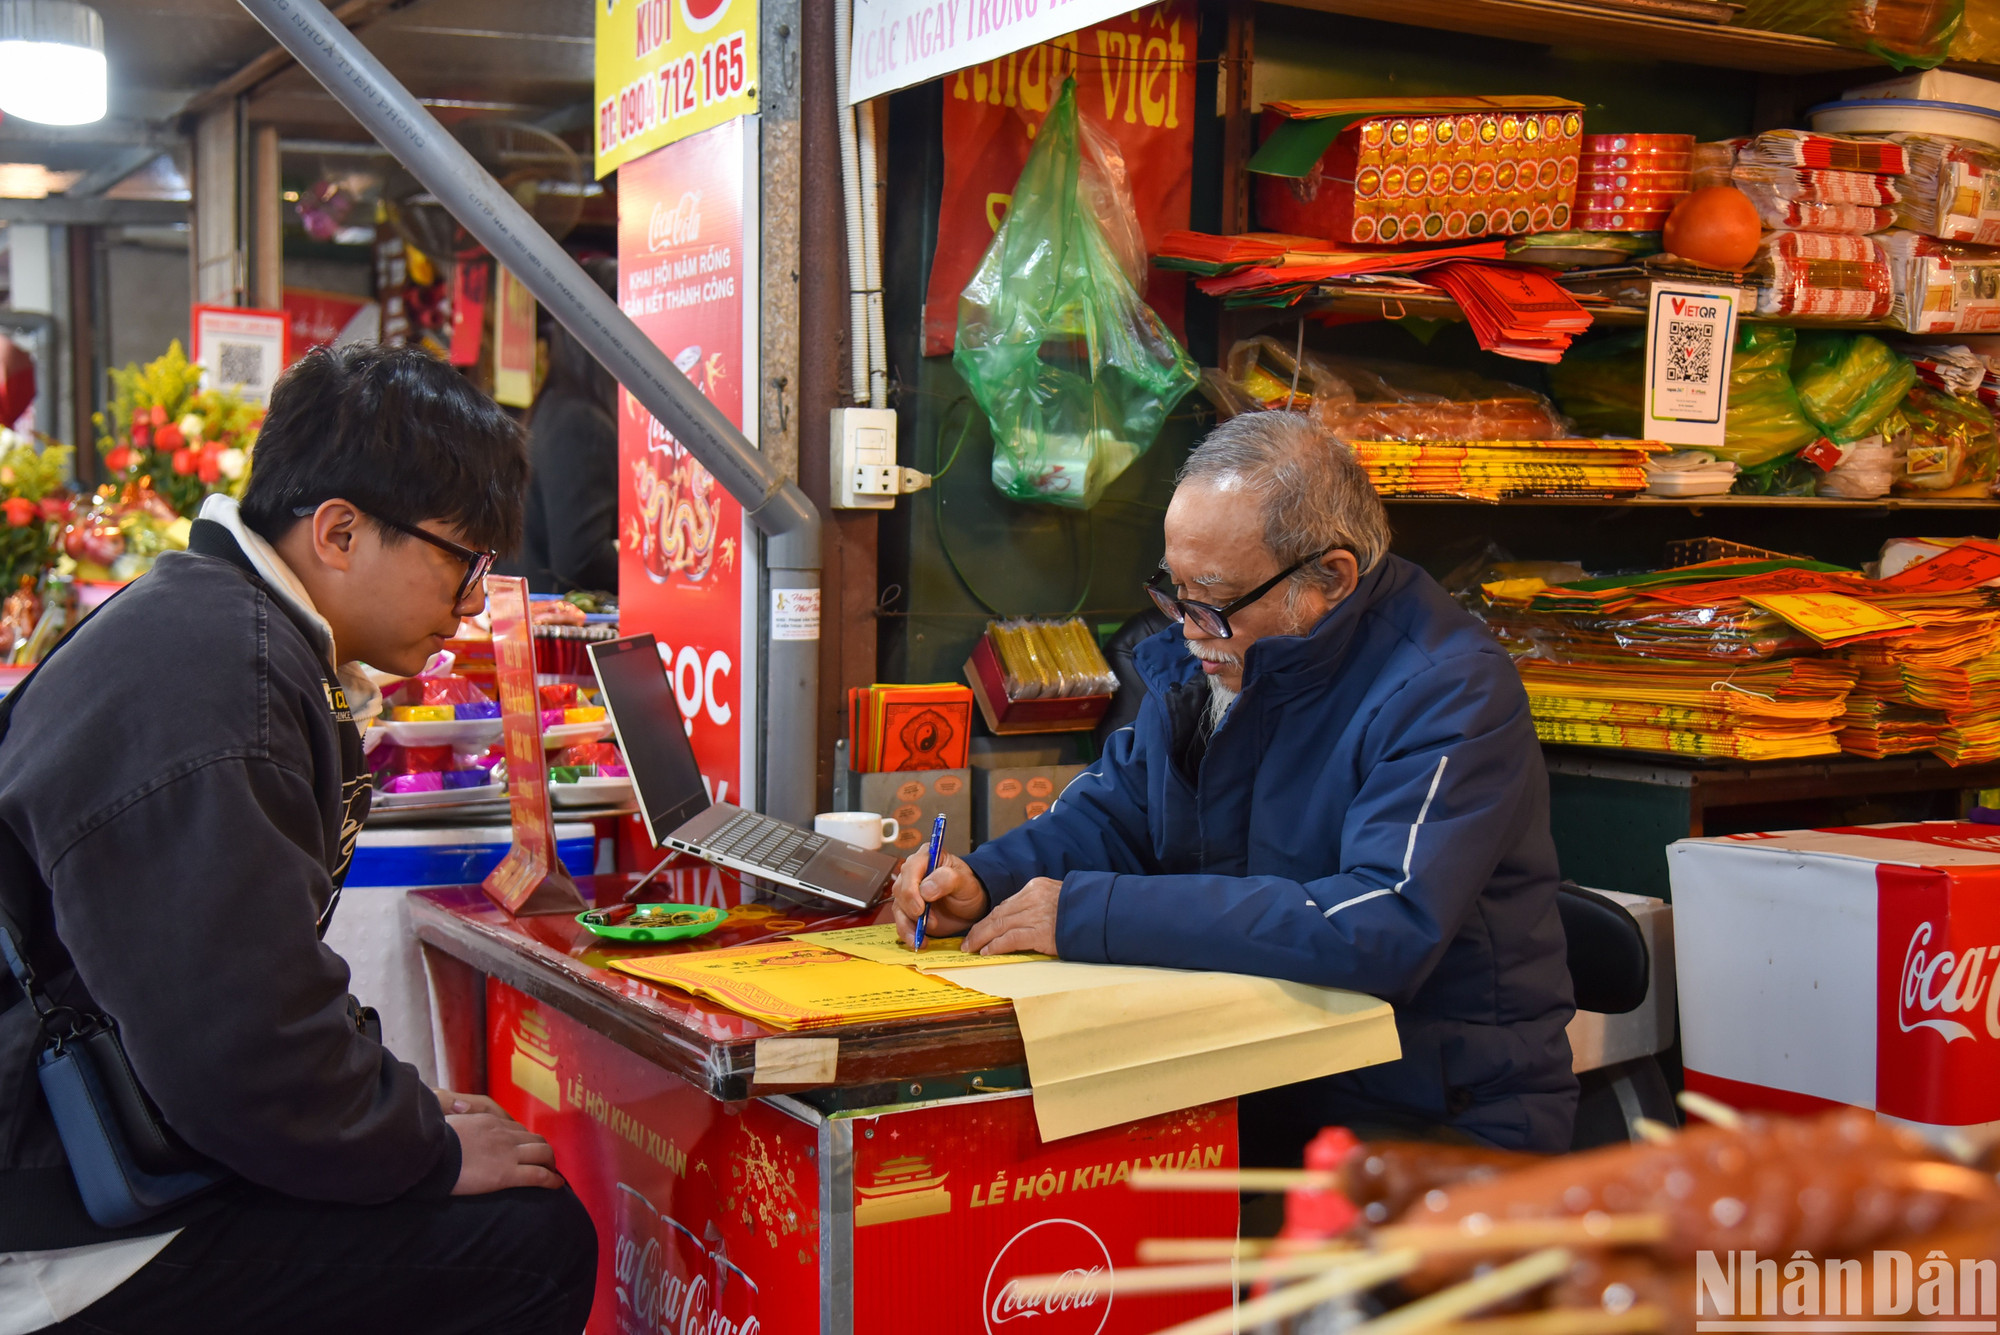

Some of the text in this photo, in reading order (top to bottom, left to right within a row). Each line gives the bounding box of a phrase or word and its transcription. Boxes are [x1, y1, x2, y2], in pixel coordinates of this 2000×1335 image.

[620, 79, 655, 139] 0904
[660, 58, 694, 118] 712
[702, 37, 743, 100] 165
[703, 276, 735, 302] CÔNG
[585, 1091, 609, 1125] HỘI
[610, 1105, 644, 1150] KHAI
[646, 1137, 687, 1180] XUÂN
[970, 1143, 1223, 1208] LỄ HỘI KHAI XUÂN
